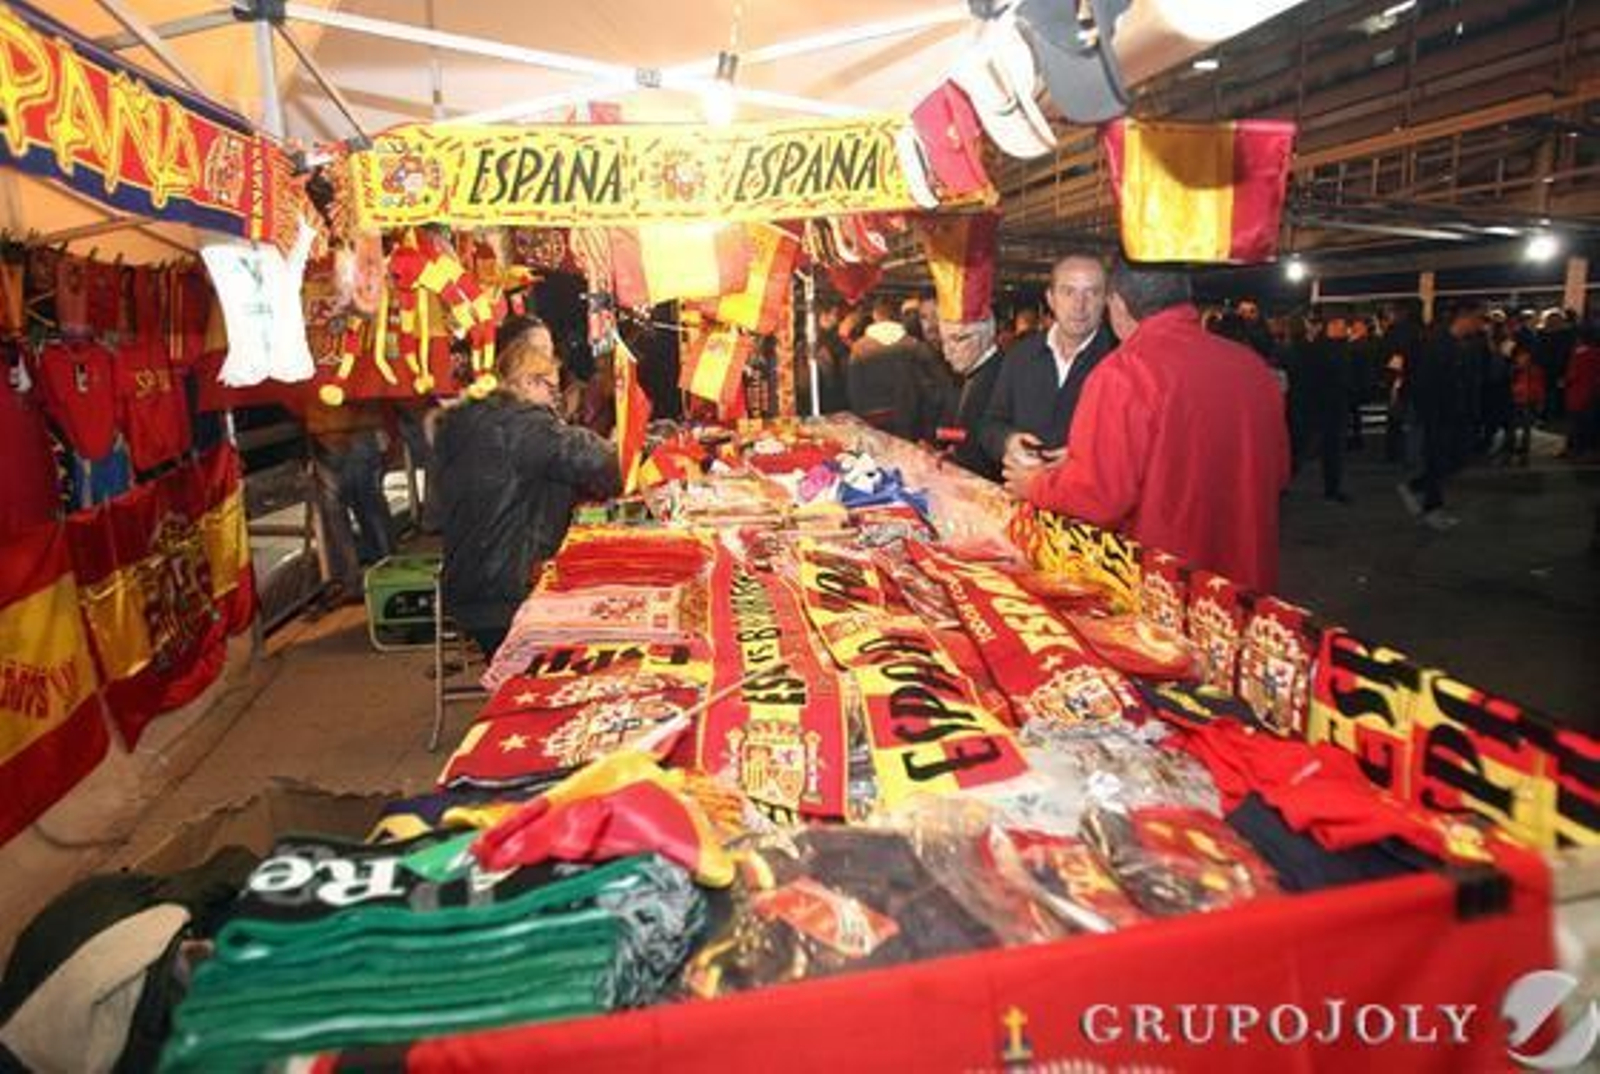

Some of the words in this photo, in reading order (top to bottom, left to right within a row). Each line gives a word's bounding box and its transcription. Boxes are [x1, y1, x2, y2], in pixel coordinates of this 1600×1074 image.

[468, 143, 622, 205] ESPAÑA
[733, 133, 879, 202] ESPAÑA
[249, 856, 406, 906] Re
